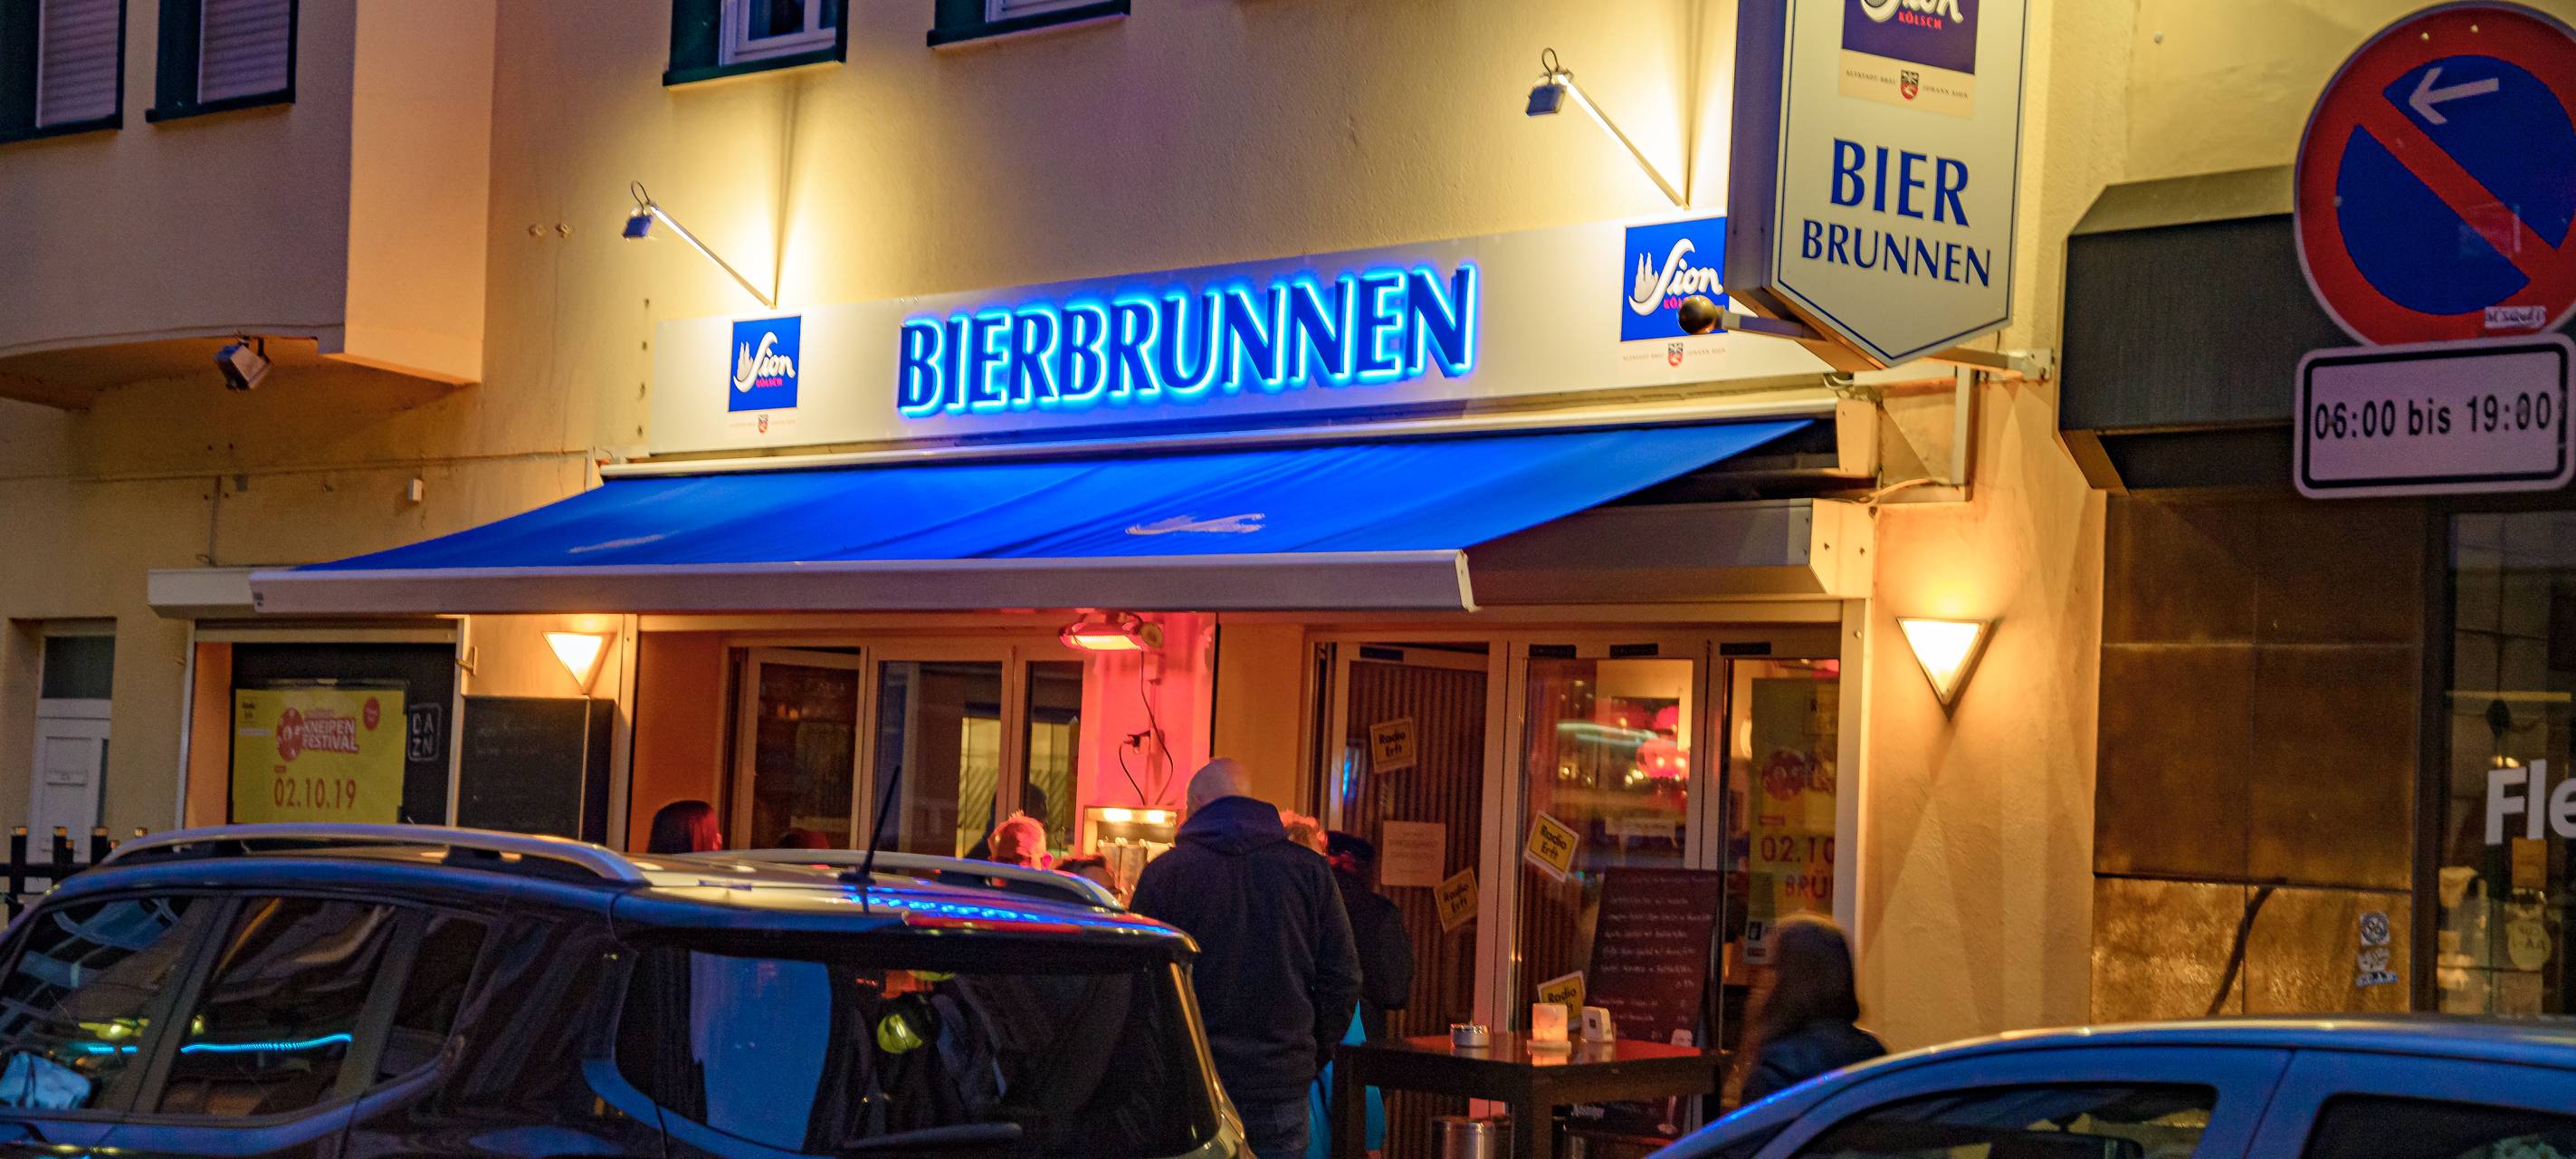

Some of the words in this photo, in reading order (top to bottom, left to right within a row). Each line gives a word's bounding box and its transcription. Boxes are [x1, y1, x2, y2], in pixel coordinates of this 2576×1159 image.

[1830, 137, 1970, 227] BIER
[1801, 218, 1991, 288] BRUNNEN
[1628, 238, 1724, 316] Sion
[896, 265, 1474, 415] BIERBRUNNEN
[733, 331, 796, 393] Sion
[2314, 400, 2396, 440] 06:00
[2408, 398, 2452, 436] bis
[2466, 390, 2552, 433] 19:00
[302, 732, 358, 752] FESTIVAL
[1379, 731, 1406, 745] Radio
[274, 777, 356, 809] 02.10.19
[2485, 759, 2576, 846] Fle
[1541, 825, 1568, 850] Radio
[1541, 842, 1560, 859] Erft
[1443, 881, 1470, 903] Radio
[1784, 868, 1834, 899] BRÜ
[1547, 985, 1577, 1004] Radio
